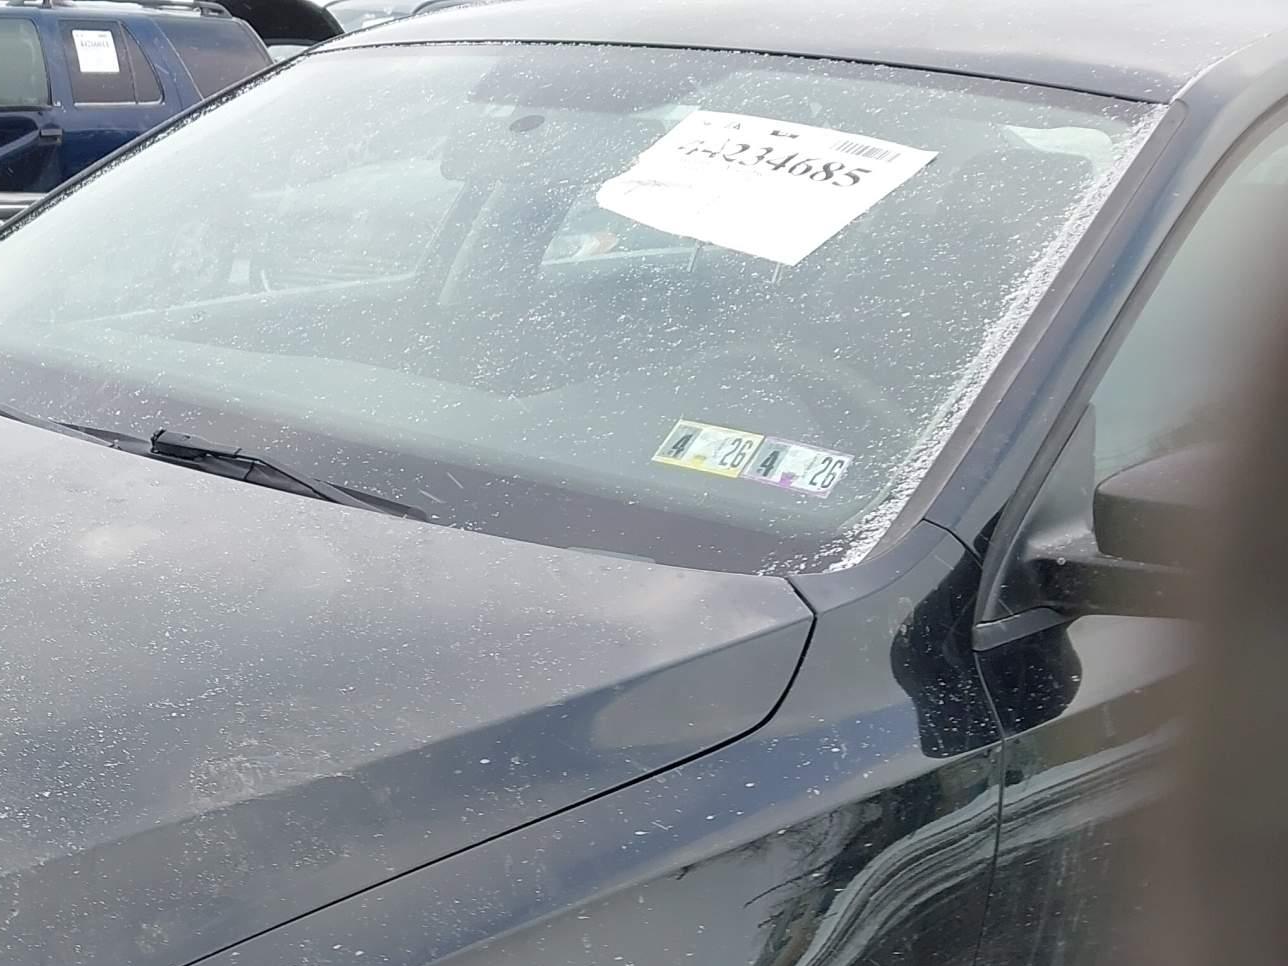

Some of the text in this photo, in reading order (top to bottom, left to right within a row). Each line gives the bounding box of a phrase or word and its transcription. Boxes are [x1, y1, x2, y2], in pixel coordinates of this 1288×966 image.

[667, 433, 753, 469] 4 26
[757, 450, 845, 489] 4 26
